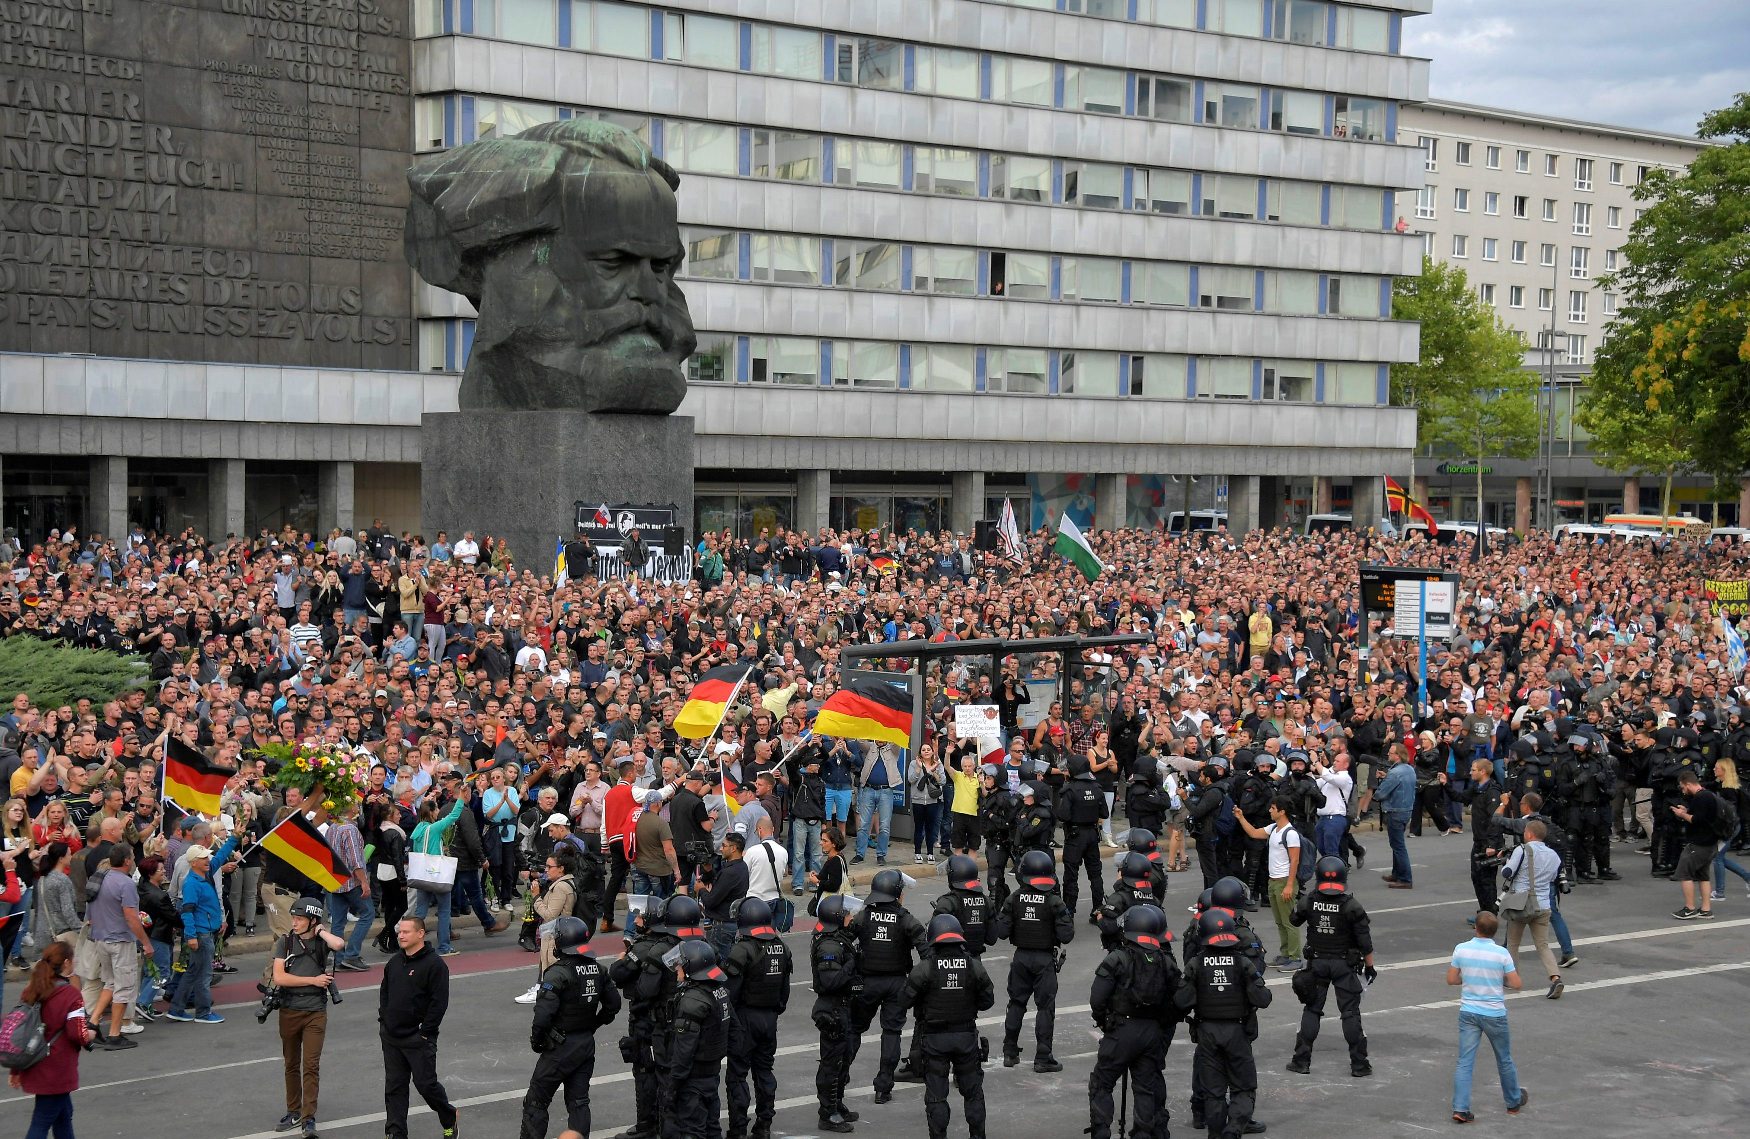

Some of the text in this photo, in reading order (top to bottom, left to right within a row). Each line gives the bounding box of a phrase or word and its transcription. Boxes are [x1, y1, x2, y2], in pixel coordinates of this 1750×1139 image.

[123, 152, 243, 191] EUCH!
[963, 897, 985, 907] POLIZEI
[1020, 893, 1045, 904] POLIZEI
[1312, 902, 1339, 913] POLIZEI
[870, 911, 897, 923] POLIZEI
[875, 932, 888, 940] 901
[937, 958, 967, 970] POLIZEI
[1203, 956, 1234, 967] POLIZEI
[575, 964, 600, 976] POLIZEI
[1213, 969, 1226, 977] SN
[586, 979, 595, 987] SN
[585, 986, 596, 994] 912
